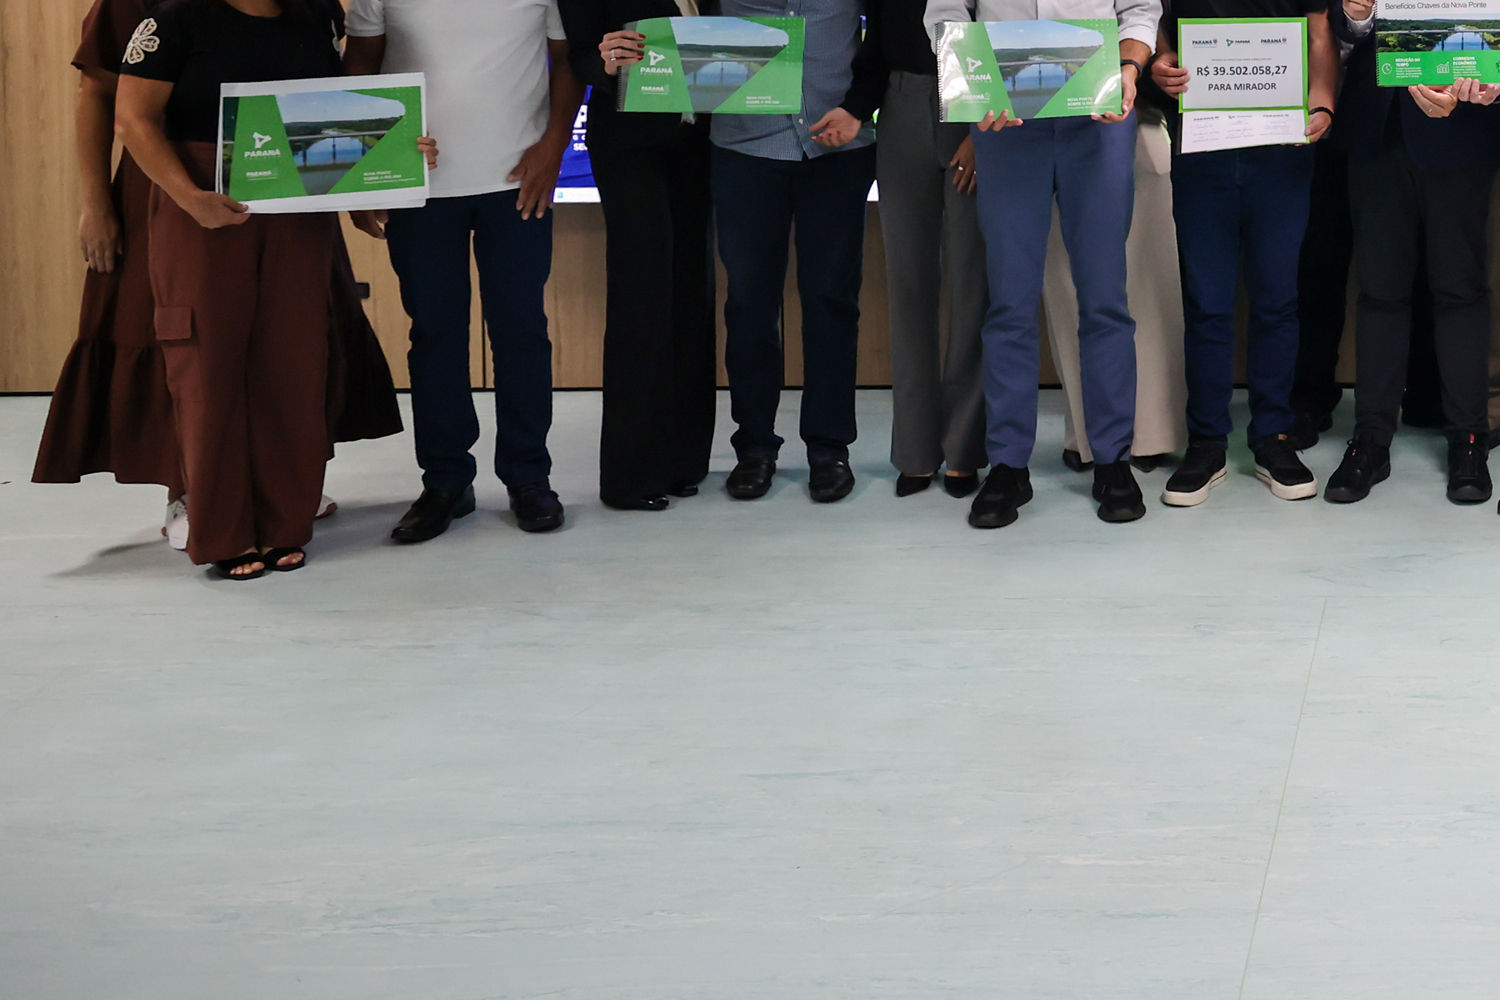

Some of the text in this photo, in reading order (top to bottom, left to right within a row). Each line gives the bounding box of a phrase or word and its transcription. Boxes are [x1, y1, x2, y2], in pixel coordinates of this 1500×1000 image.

[1385, 2, 1416, 10] Benefícios
[1197, 66, 1287, 76] R$ 39.502.058,27
[1208, 82, 1276, 91] PARA MIRADOR
[244, 149, 281, 158] PARANÁ
